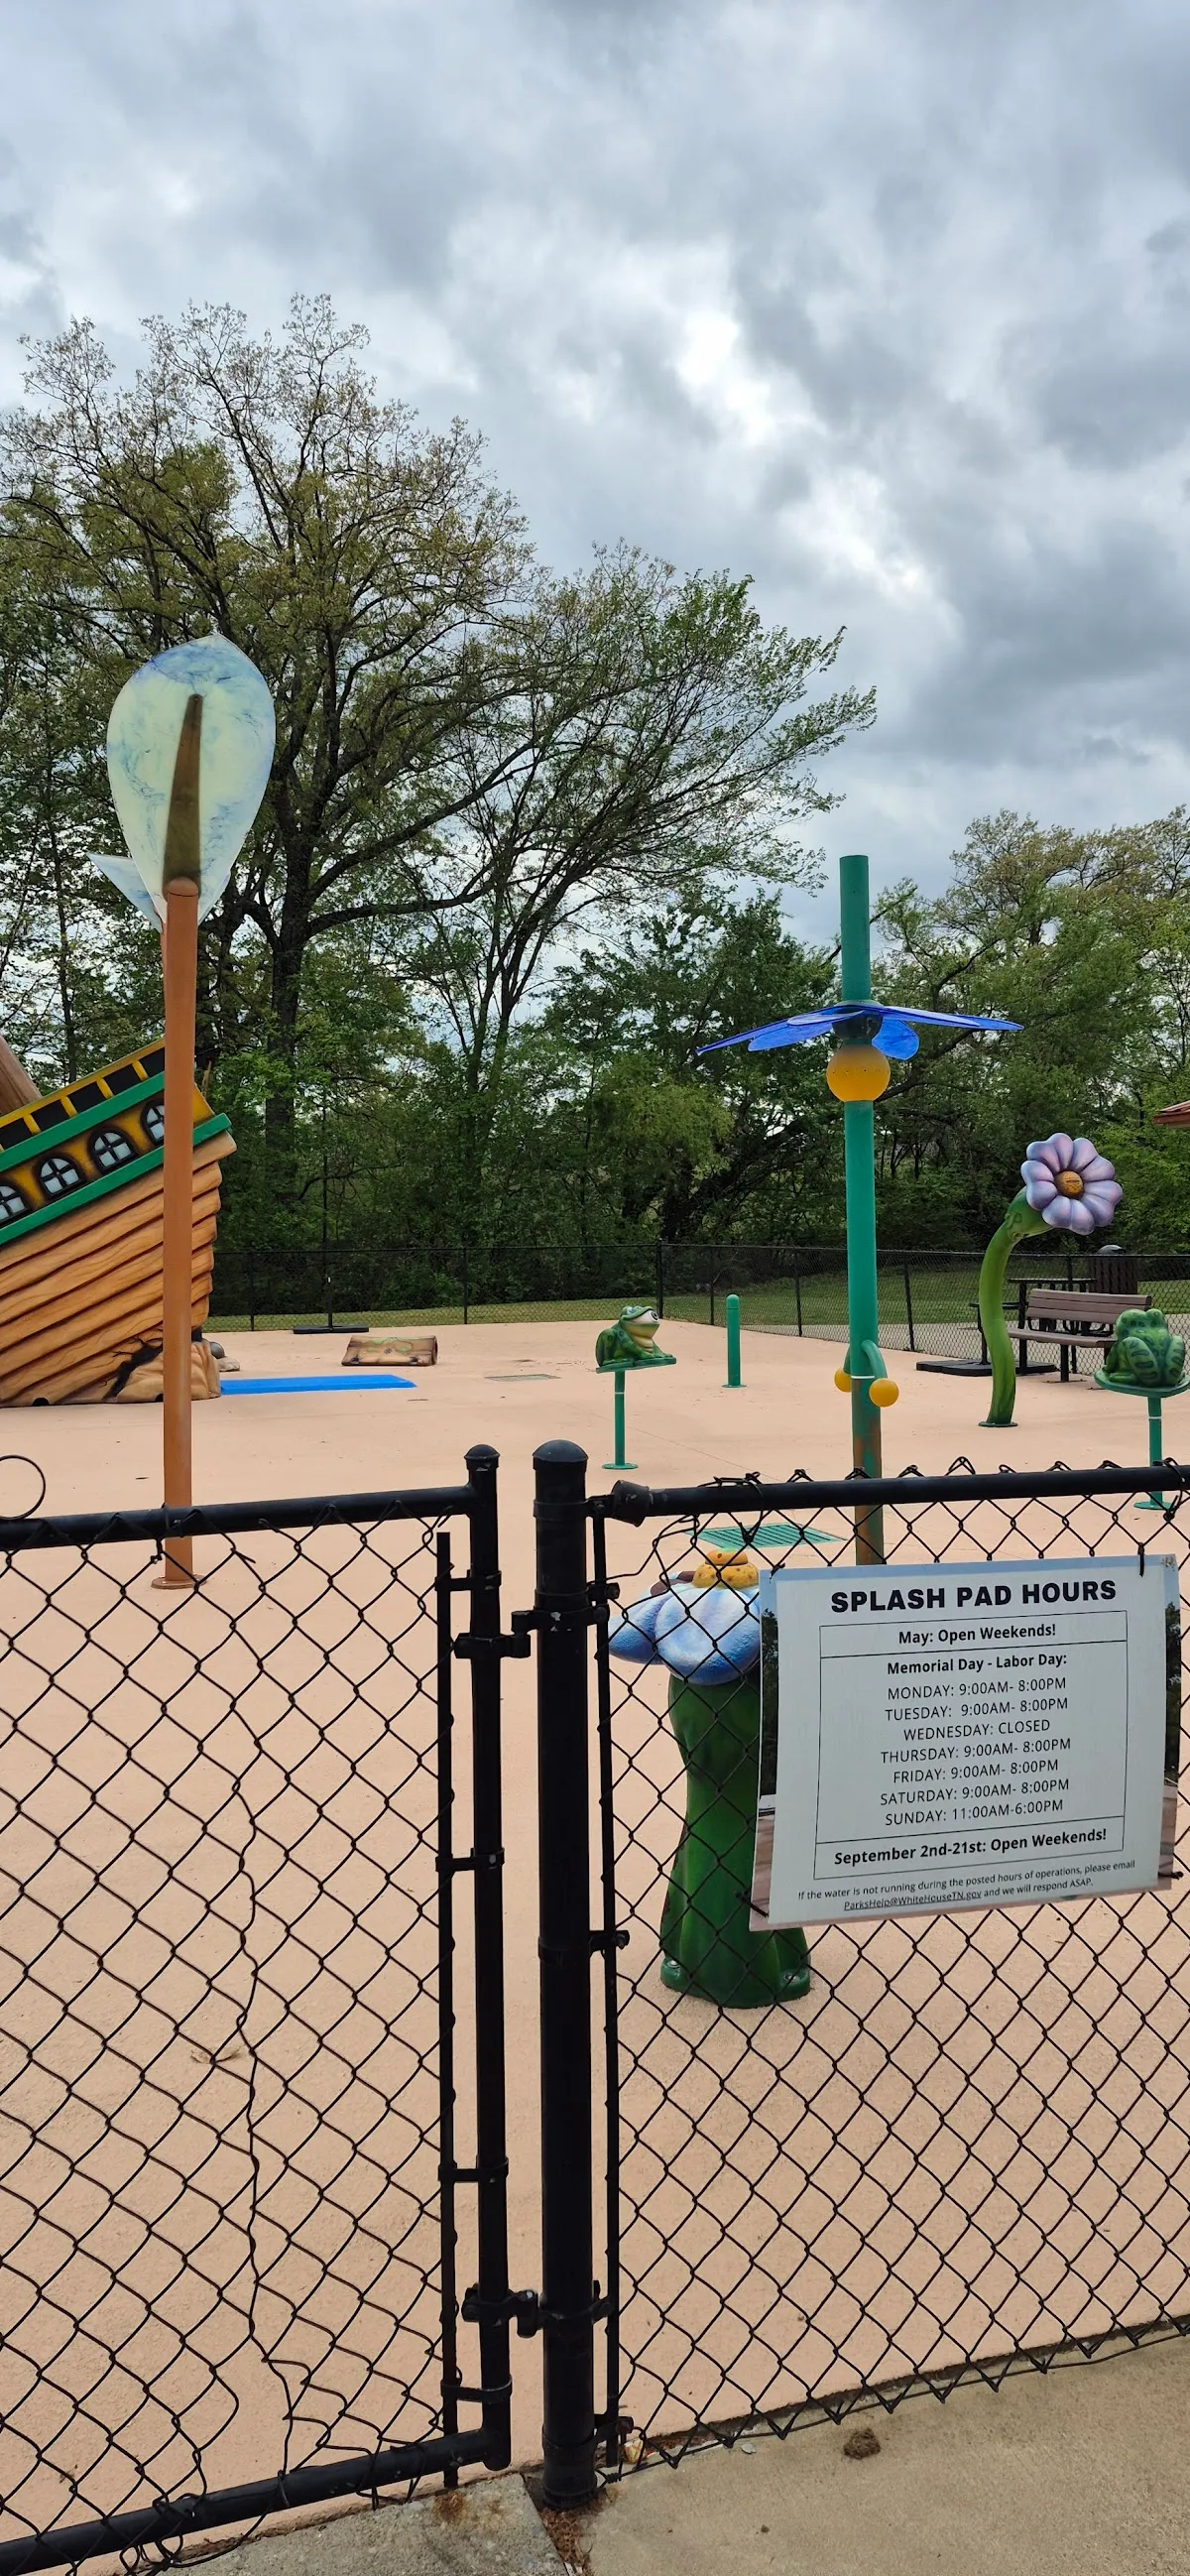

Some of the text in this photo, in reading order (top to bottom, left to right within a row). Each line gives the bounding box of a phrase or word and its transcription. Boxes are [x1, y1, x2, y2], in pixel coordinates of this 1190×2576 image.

[831, 1580, 1116, 1613] SPLASH PAD HOURS
[899, 1624, 1055, 1647] May: Open Weekends!
[888, 1658, 953, 1674] Memorial
[959, 1658, 984, 1672] Day
[997, 1656, 1034, 1667] Labor
[1039, 1655, 1066, 1667] Day:
[889, 1677, 1065, 1700] MONDAY: 9:00AM- 8:00PM
[886, 1698, 1067, 1721] TUESDAY: 9:00AM- 8:00PM
[903, 1720, 1050, 1741] WEDNESDAY: CLOSED
[882, 1738, 1070, 1763] THURSDAY: 9:00AM- 8:00PM
[893, 1760, 1057, 1783] FRIDAY: 9:00AM- 8:00PM
[881, 1779, 1068, 1804] SATURDAY: 9:00AM- 8:00PM
[886, 1800, 1062, 1825] SUNDAY: 11:00AM-6:00PM
[835, 1828, 1106, 1867] September 2nd-21st: Open Weekends!
[807, 1891, 822, 1900] the
[881, 1884, 915, 1894] running
[918, 1881, 947, 1891] during
[950, 1878, 963, 1887] the
[966, 1875, 995, 1888] posted
[1035, 1868, 1083, 1882] operations,
[1085, 1864, 1111, 1876] please
[1113, 1860, 1134, 1870] email
[844, 1891, 982, 1910] ParksHelp@WhiteHouseTN.gov
[984, 1887, 1000, 1897] and
[1016, 1884, 1030, 1894] will
[1033, 1881, 1067, 1894] respond
[1070, 1878, 1093, 1888] ASAP.
